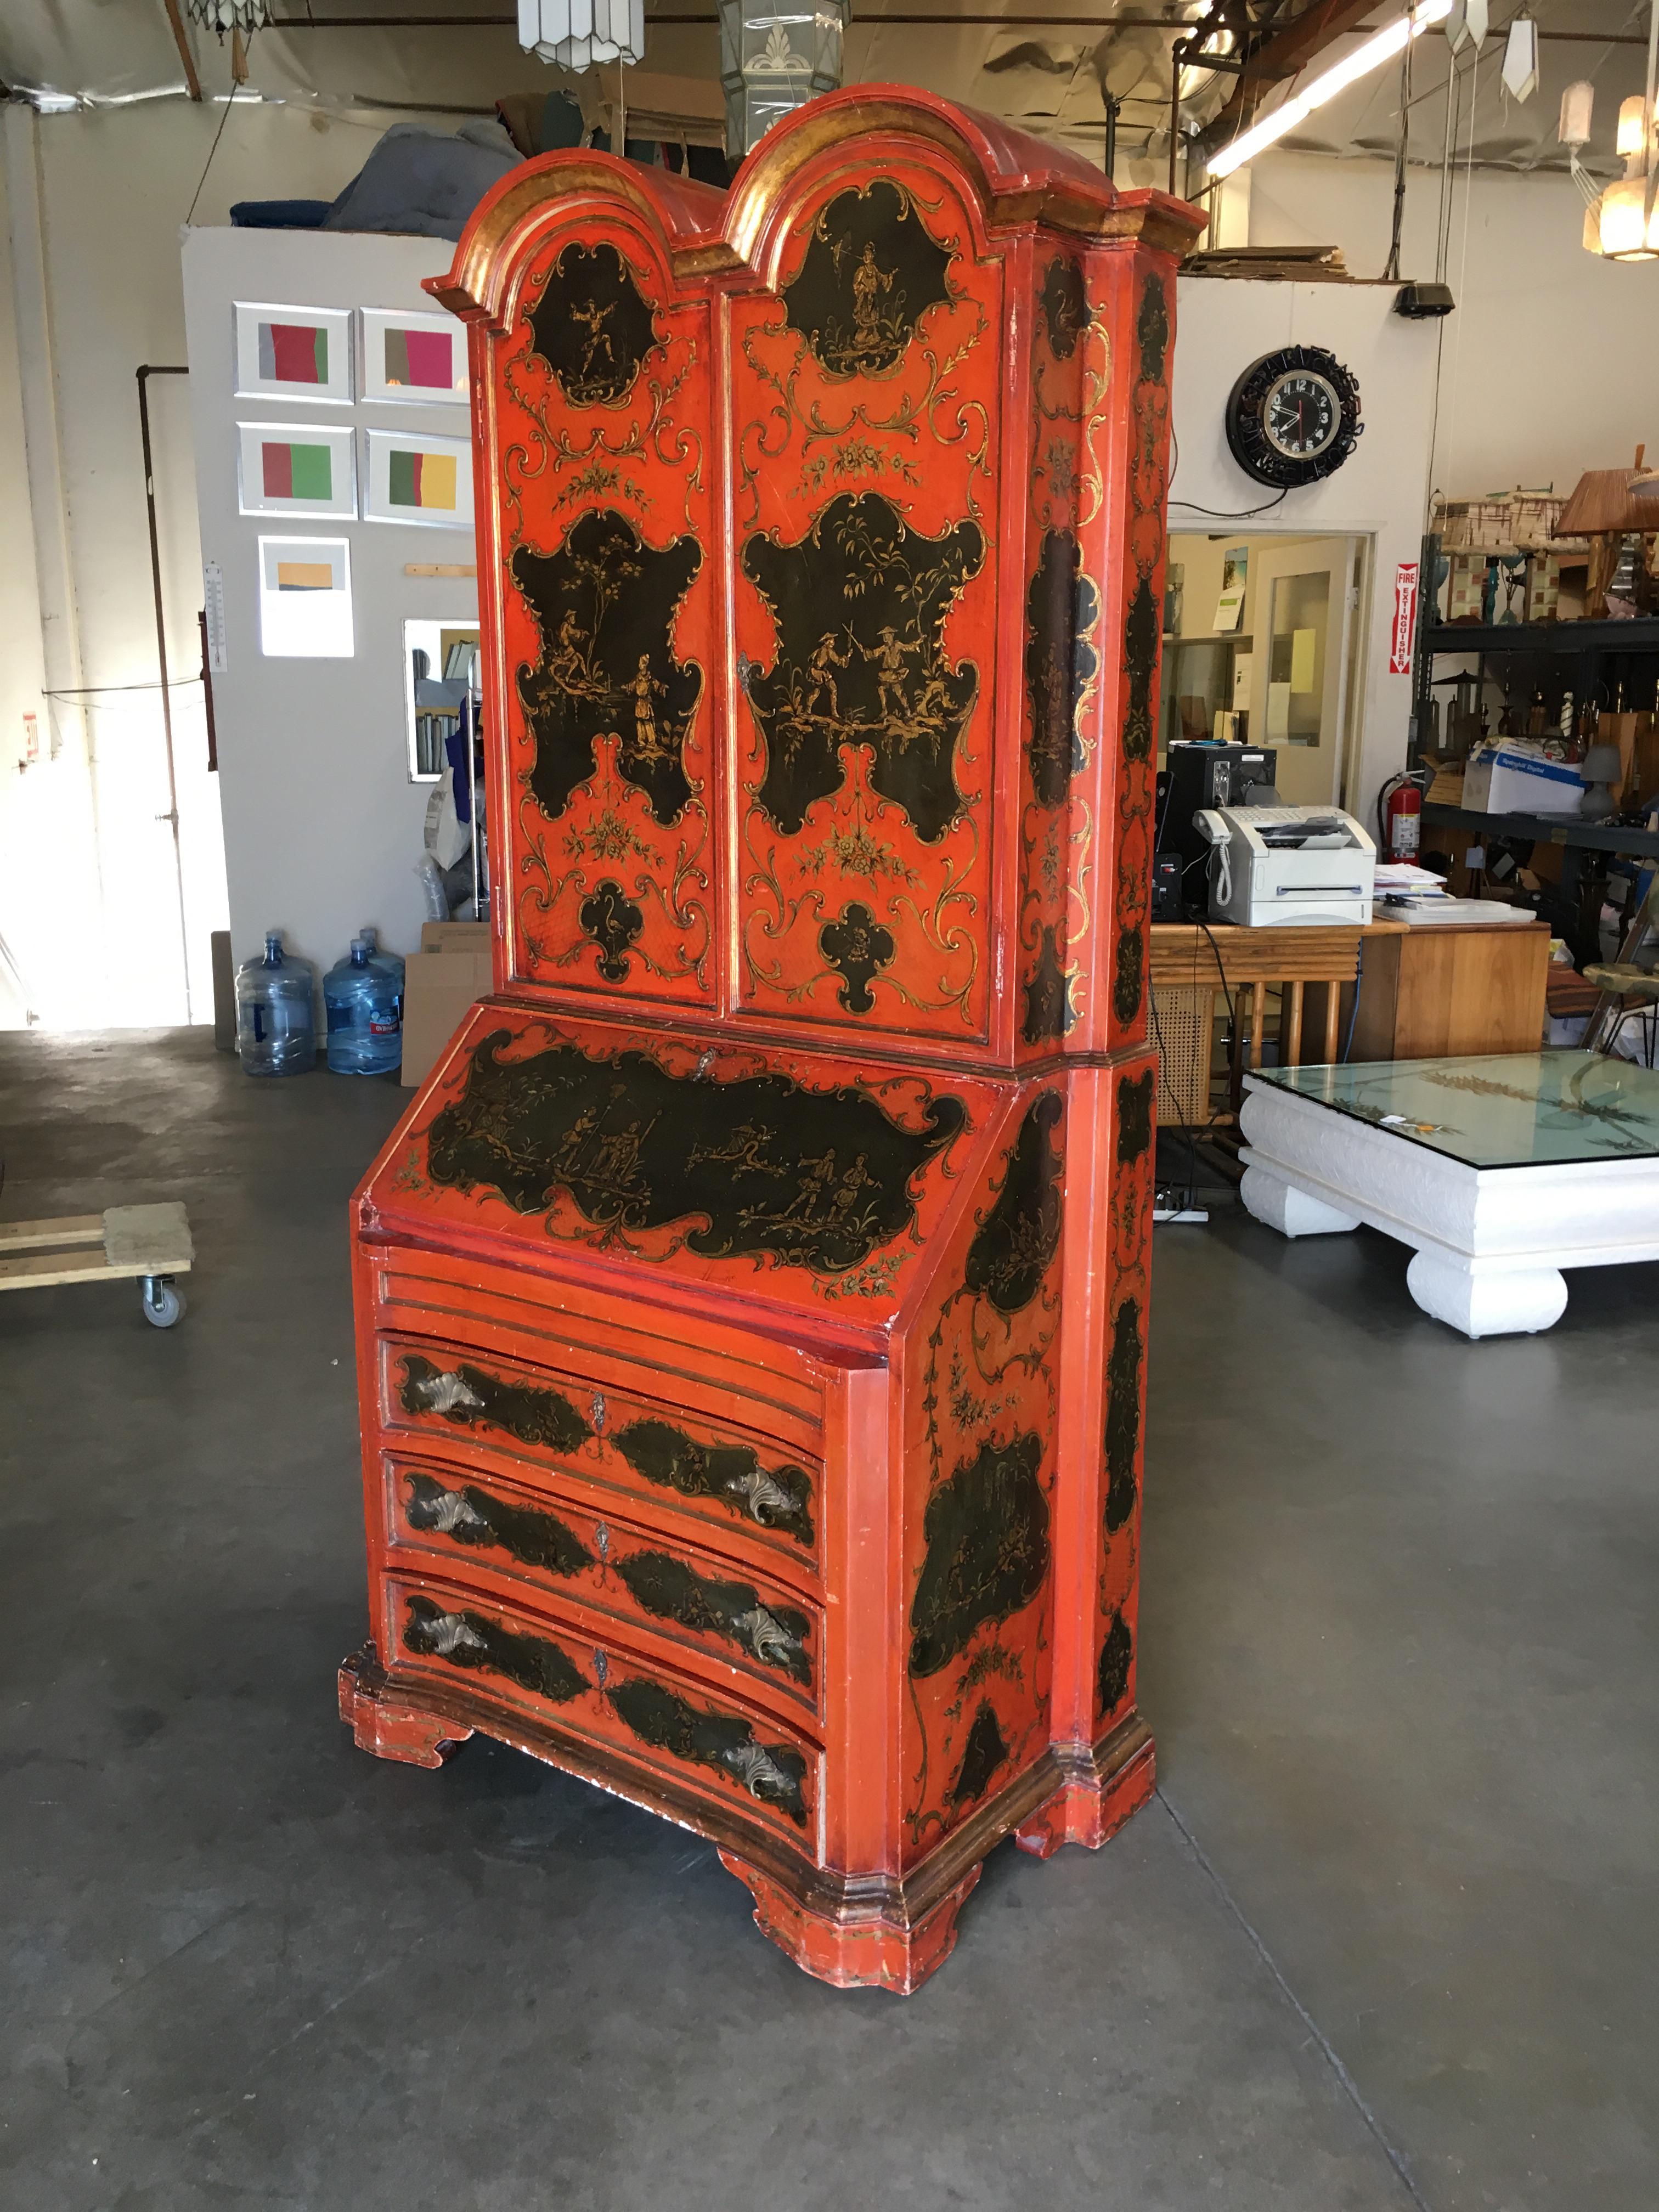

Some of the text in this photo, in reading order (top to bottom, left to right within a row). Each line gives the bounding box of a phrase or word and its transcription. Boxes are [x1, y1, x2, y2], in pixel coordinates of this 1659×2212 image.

[1284, 382, 1291, 394] 11
[1296, 379, 1307, 391] 12
[1312, 384, 1315, 395] 1
[1321, 396, 1328, 407] 2
[1269, 410, 1276, 421] 9
[1321, 412, 1329, 424] 3
[1272, 426, 1279, 437] 8
[1315, 428, 1324, 439] 4
[1279, 438, 1287, 447] 7
[1291, 442, 1300, 452] 6
[1306, 440, 1314, 450] 5
[1398, 573, 1415, 583] FIRE
[1398, 588, 1408, 667] EXTINGUISHER
